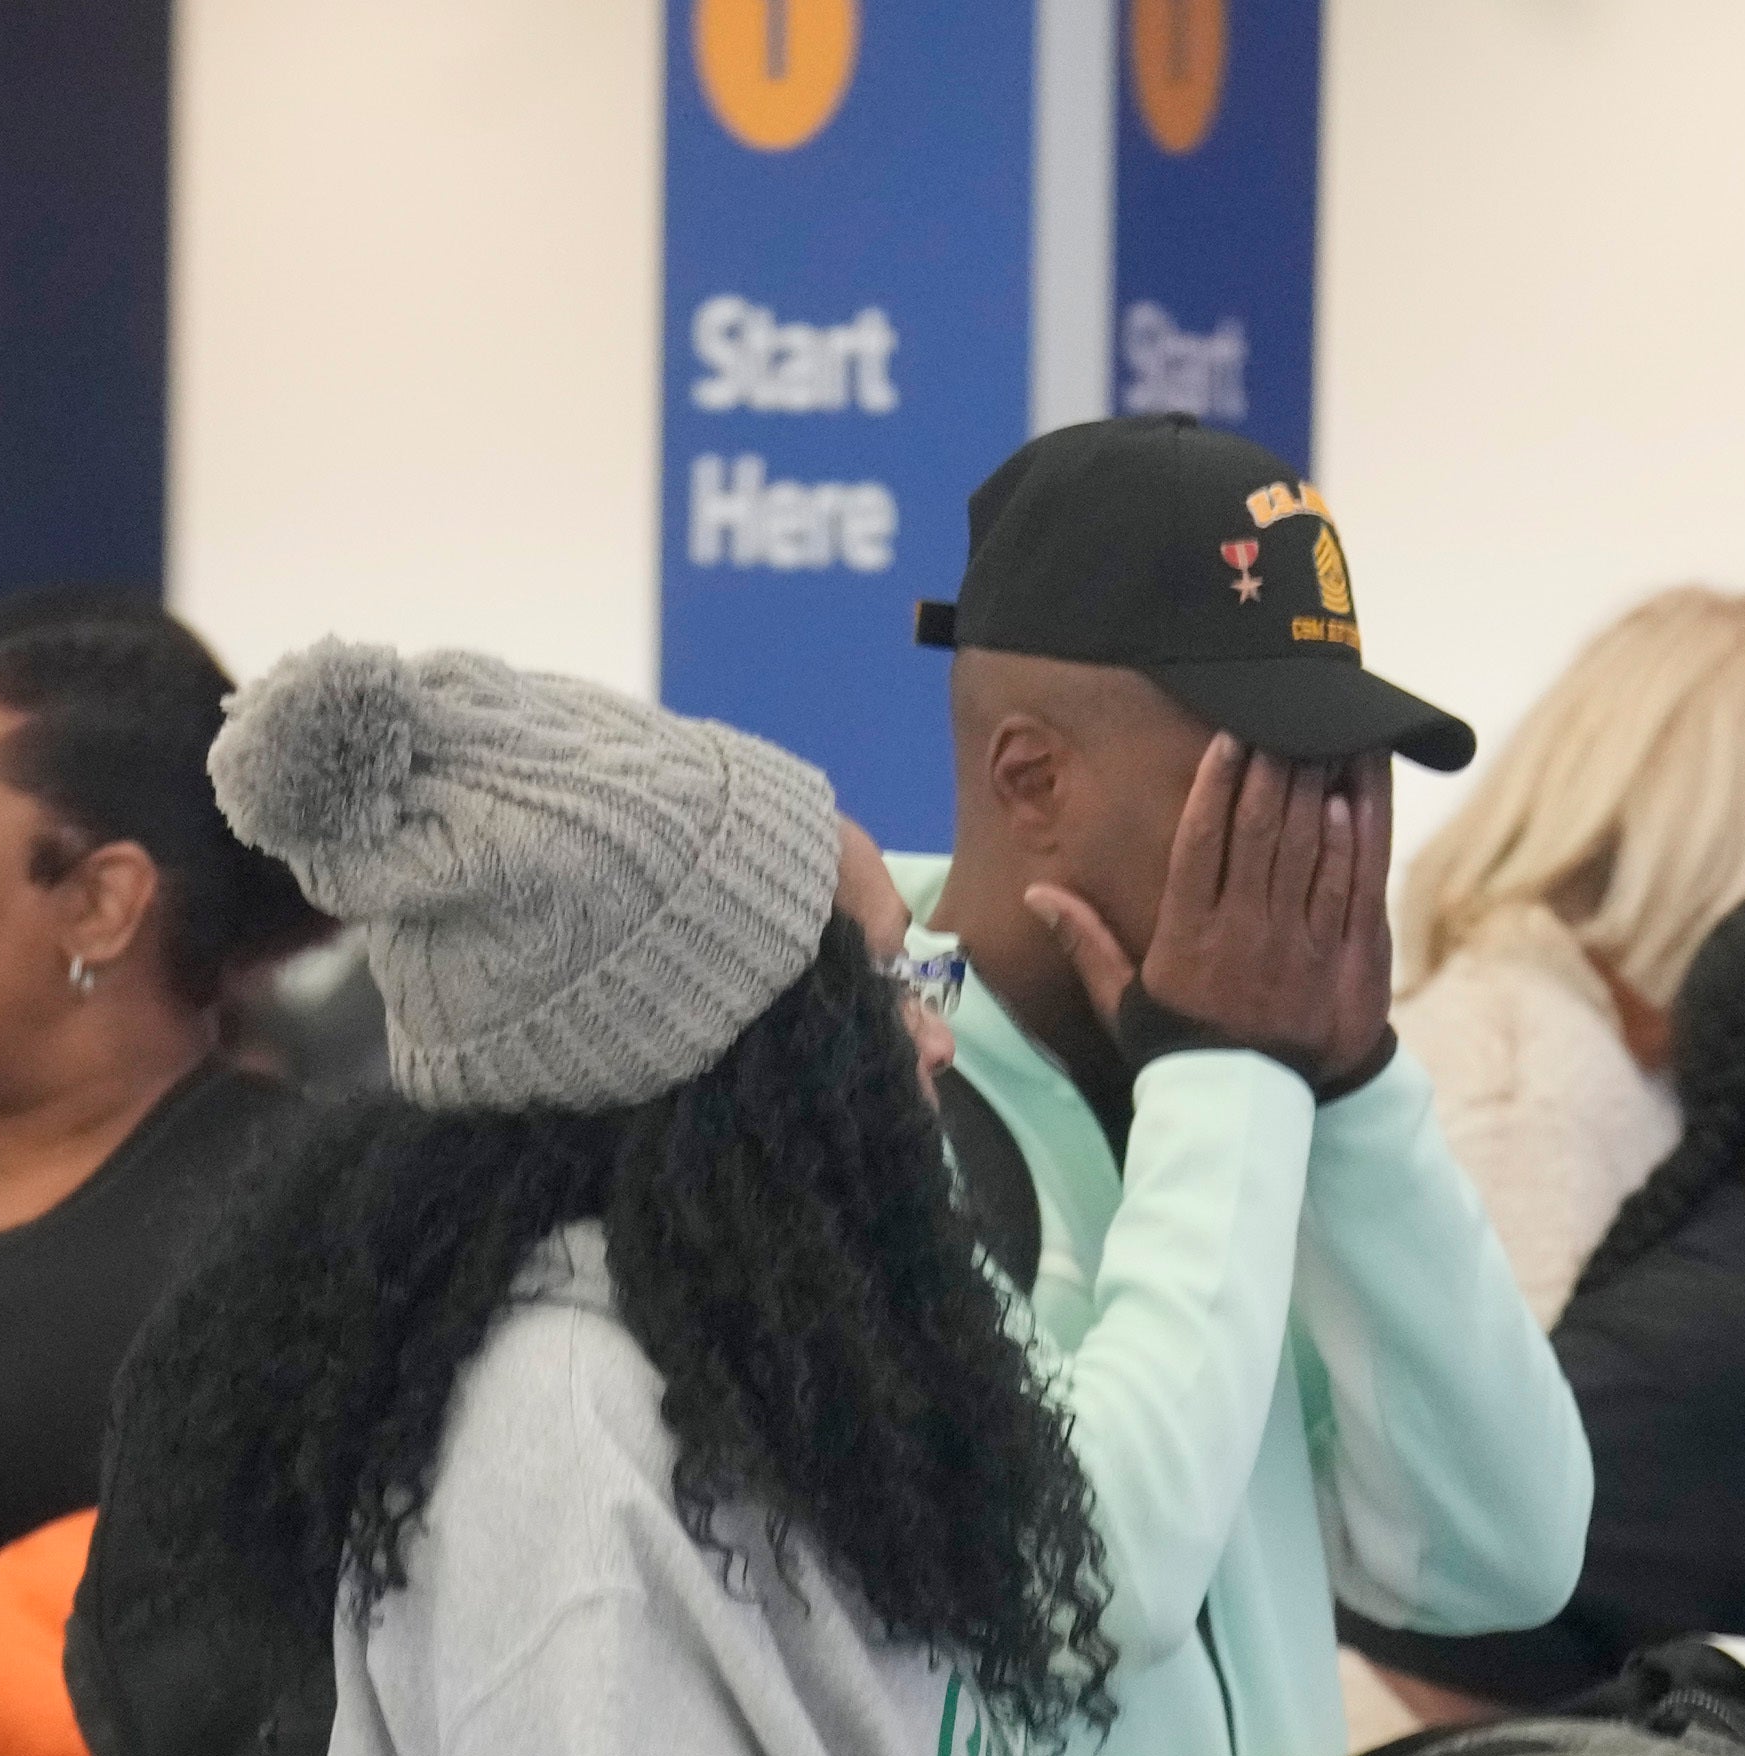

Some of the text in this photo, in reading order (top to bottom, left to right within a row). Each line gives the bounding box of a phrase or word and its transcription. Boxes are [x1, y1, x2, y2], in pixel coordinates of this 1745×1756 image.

[692, 296, 898, 413] Start
[1126, 302, 1248, 421] Start
[689, 453, 899, 570] Here
